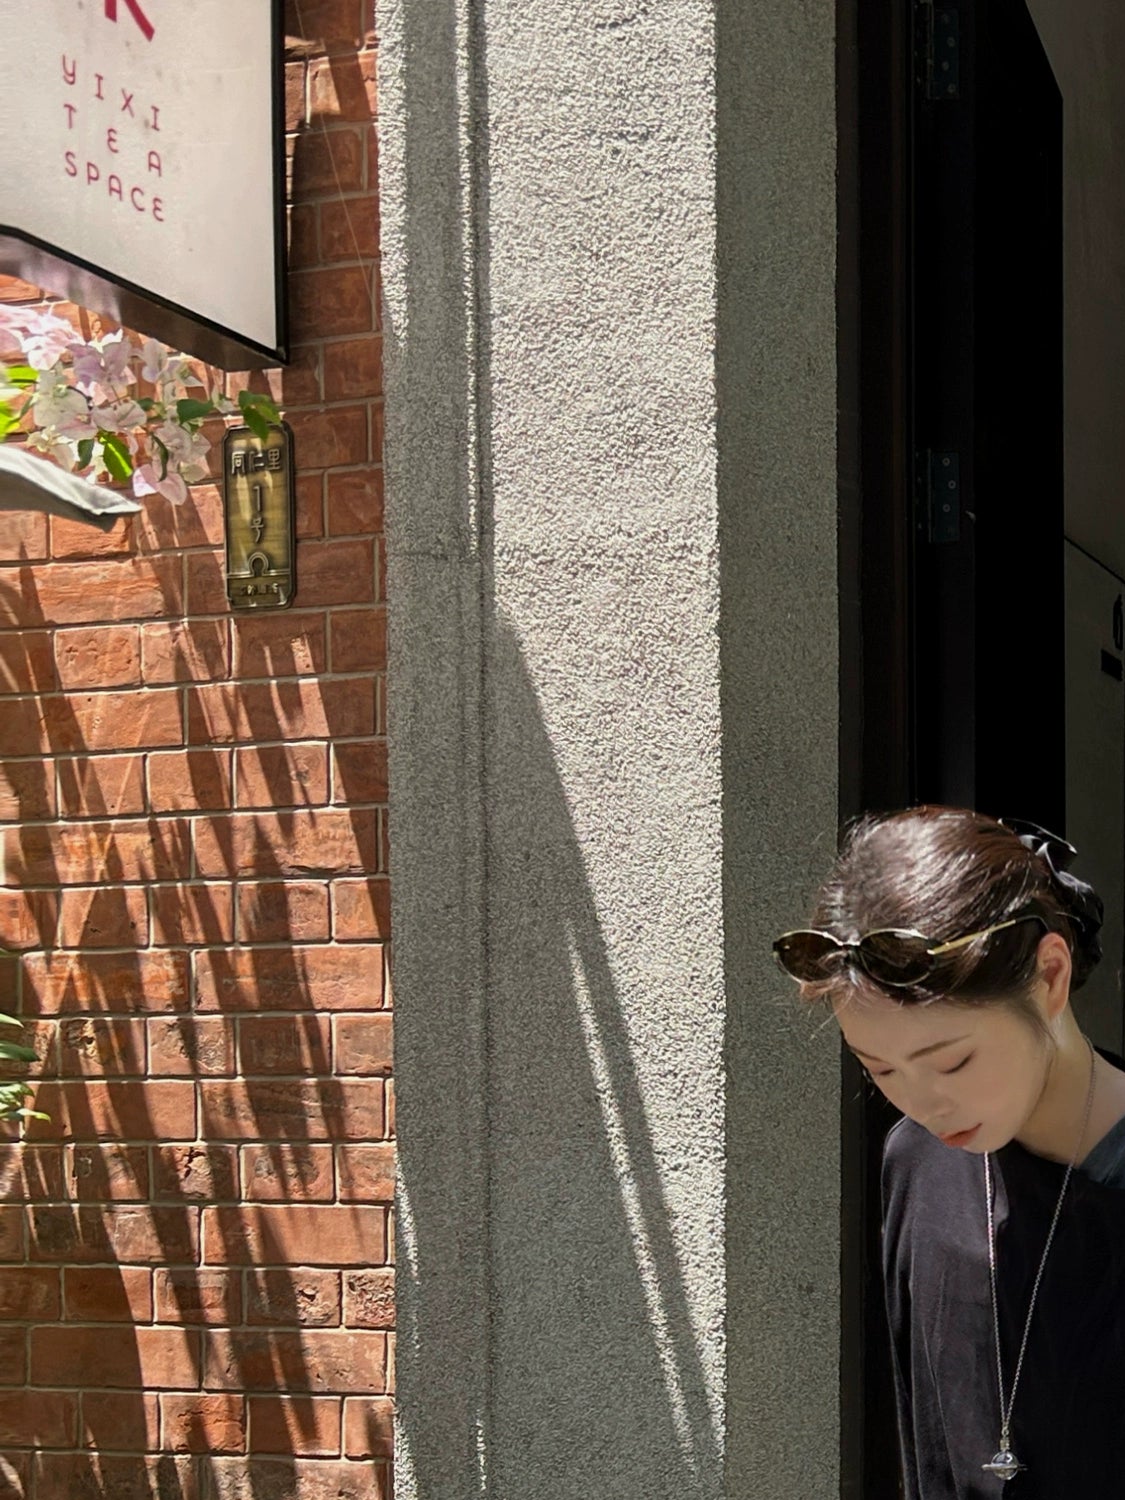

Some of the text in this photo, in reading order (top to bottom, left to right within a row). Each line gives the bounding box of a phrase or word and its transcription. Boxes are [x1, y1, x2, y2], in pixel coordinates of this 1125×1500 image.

[62, 54, 160, 131] YIXI
[63, 103, 162, 177] TEA
[64, 151, 164, 222] SPACE
[231, 448, 281, 475] 同仁里
